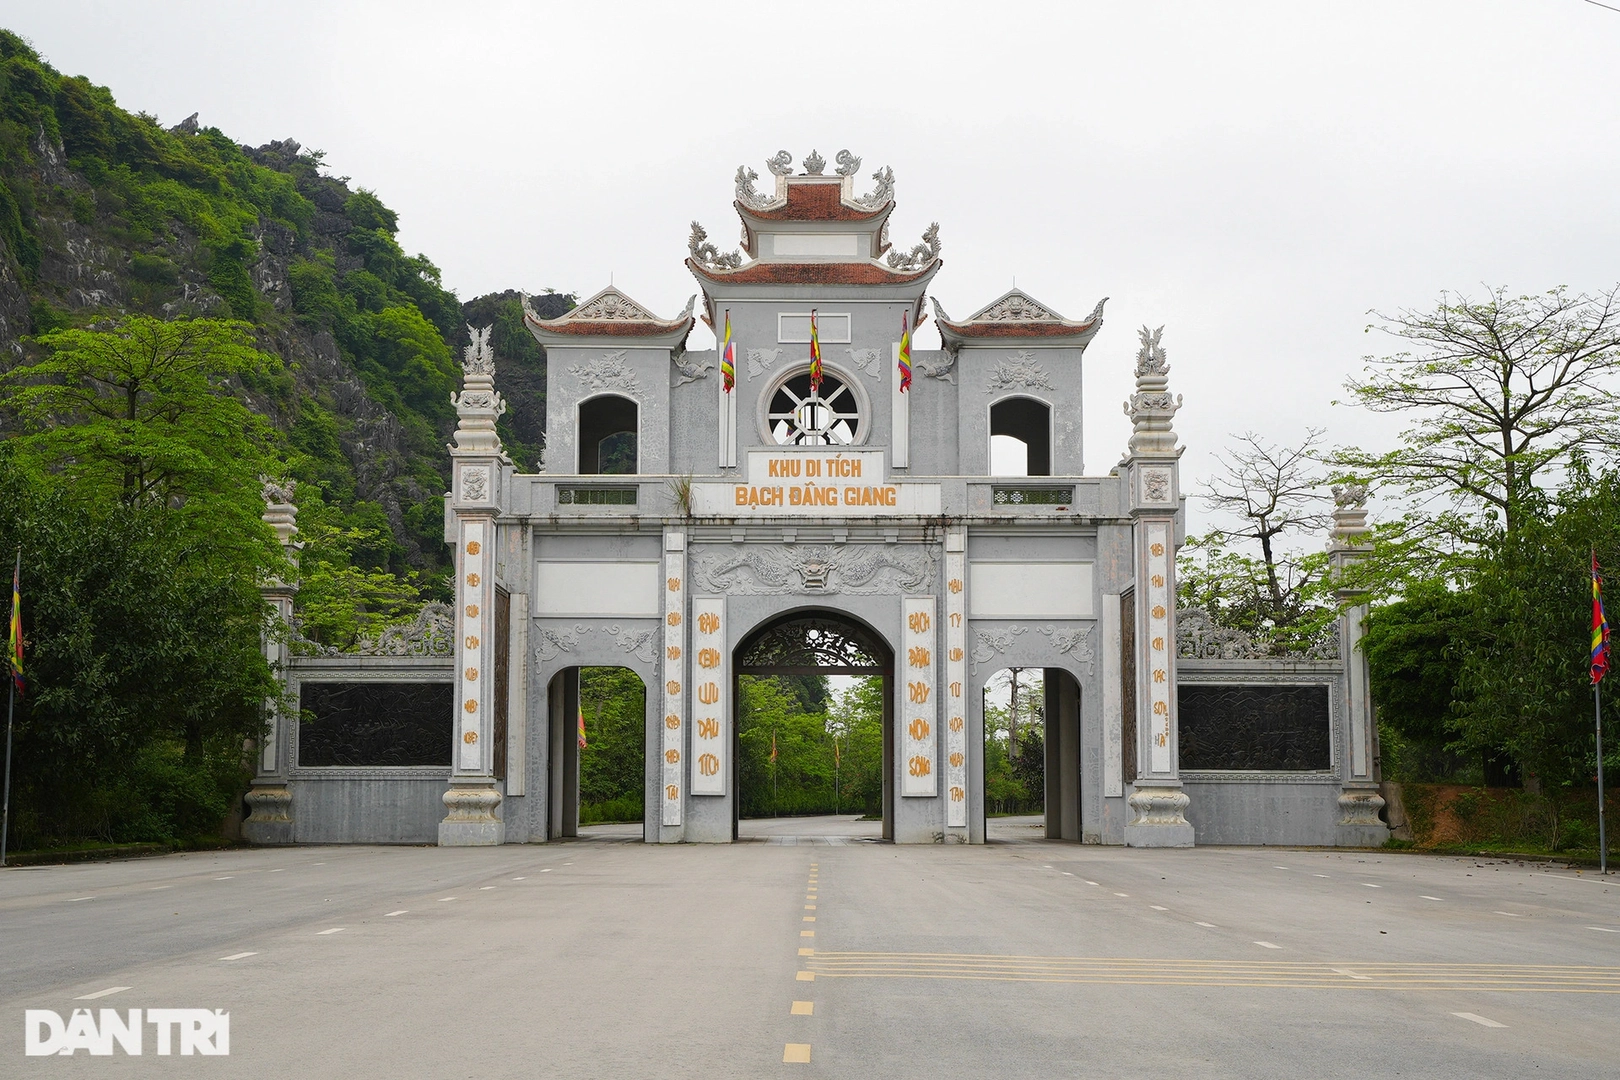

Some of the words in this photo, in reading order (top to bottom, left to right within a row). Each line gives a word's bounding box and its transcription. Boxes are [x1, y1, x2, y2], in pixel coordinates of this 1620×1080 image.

[769, 460, 801, 477] KHU
[806, 459, 821, 477] DI
[826, 454, 861, 477] TÍCH
[735, 486, 784, 509] BẠCH
[844, 487, 896, 506] GIANG
[698, 614, 720, 633] TRÀNG
[698, 648, 720, 668] KÊNH
[909, 718, 930, 740] NON
[698, 754, 719, 775] TÍCH
[909, 756, 930, 776] SÔNG
